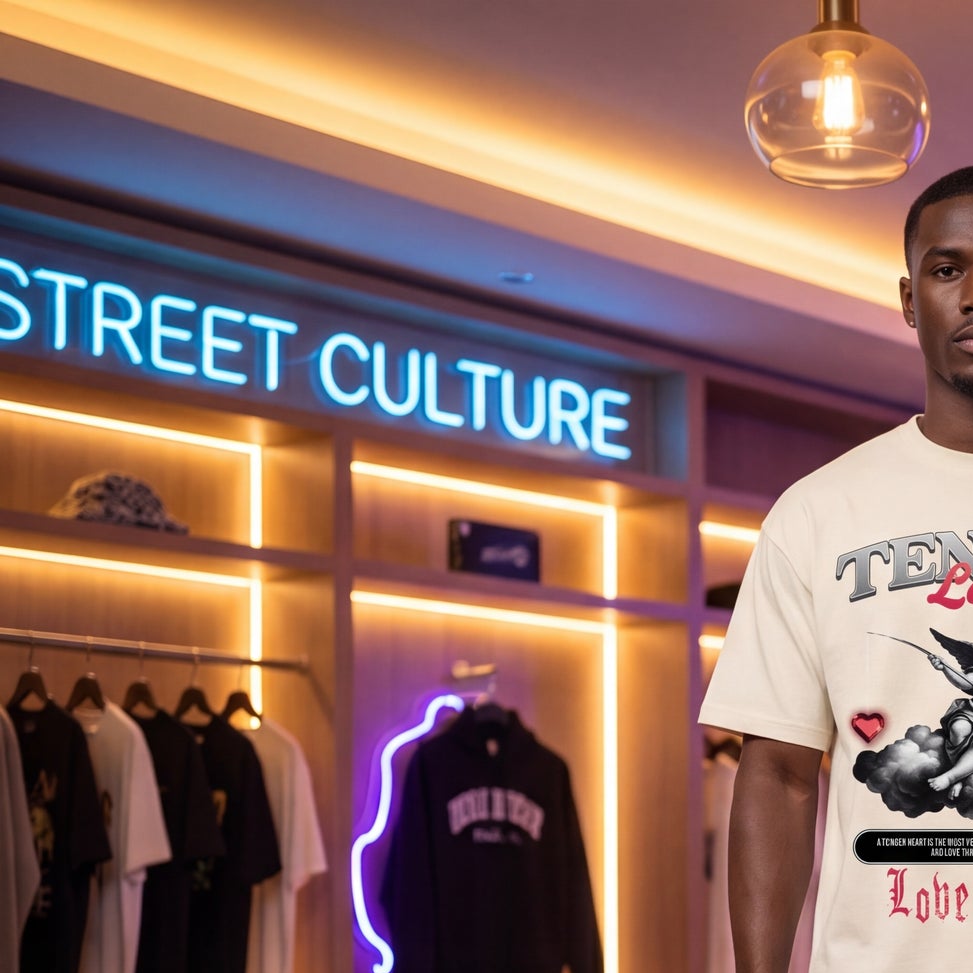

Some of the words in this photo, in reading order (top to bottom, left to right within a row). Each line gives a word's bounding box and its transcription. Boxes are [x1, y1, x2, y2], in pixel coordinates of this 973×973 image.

[0, 256, 298, 391] STREET
[319, 332, 632, 460] CULTURE
[935, 837, 947, 847] THE
[944, 847, 961, 857] LOVE
[886, 867, 969, 924] Love
